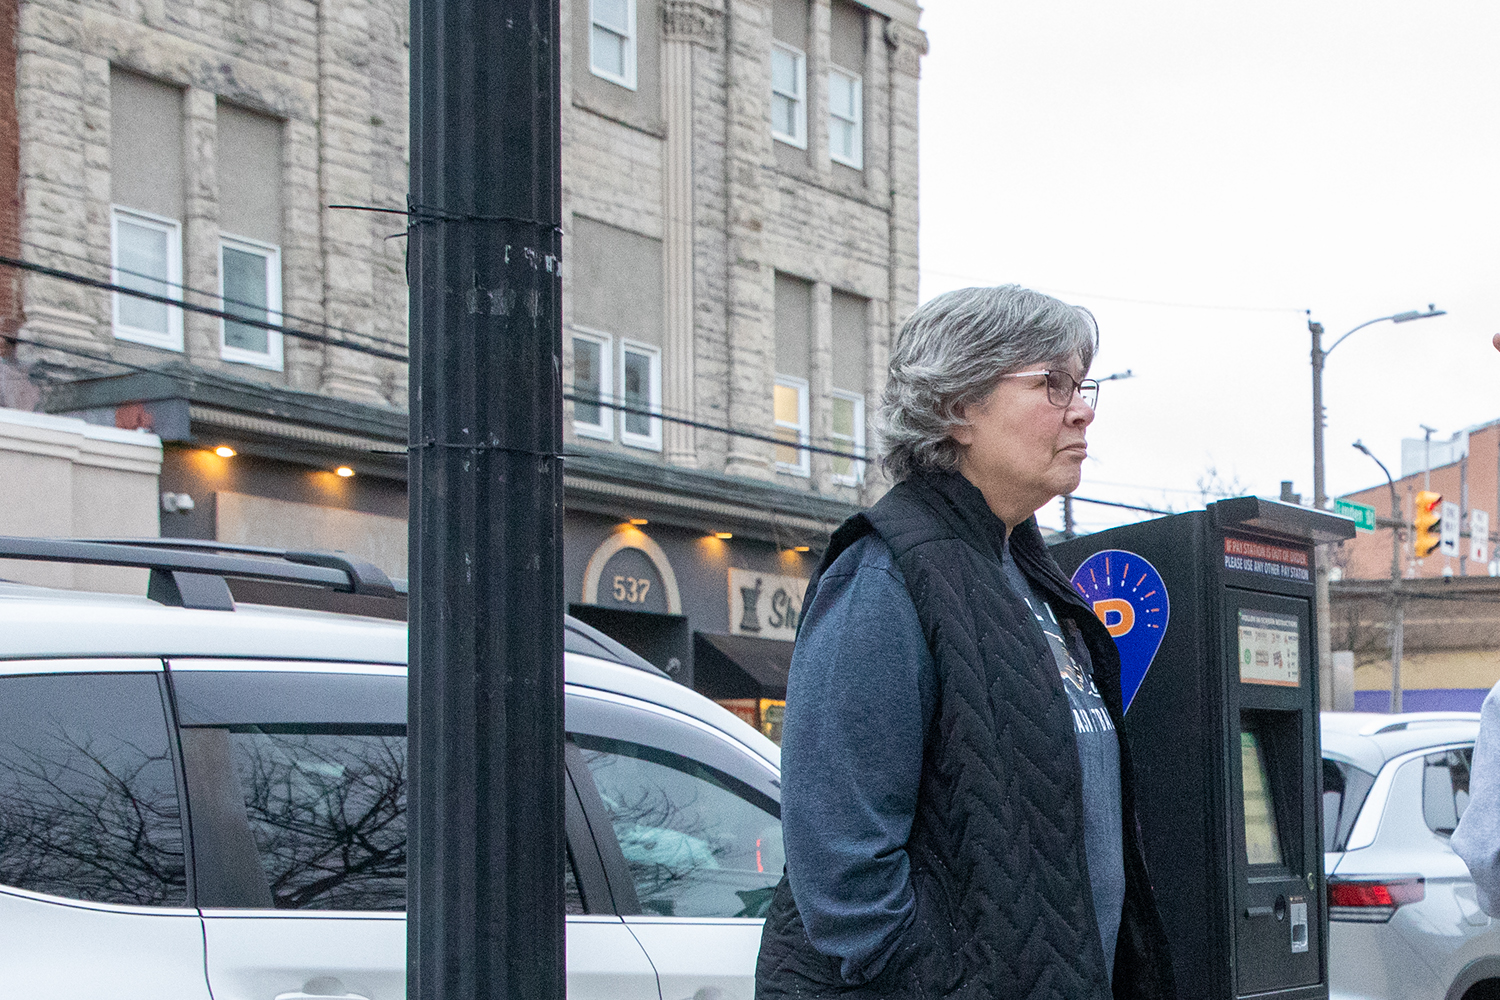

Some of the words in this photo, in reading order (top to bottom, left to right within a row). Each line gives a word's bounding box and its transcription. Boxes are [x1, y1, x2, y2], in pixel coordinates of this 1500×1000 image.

[1232, 540, 1243, 553] PAY
[1243, 541, 1266, 557] STATION
[1225, 555, 1243, 570] PLEASE
[1243, 558, 1253, 571] USE
[1254, 560, 1264, 573] ANY
[1264, 562, 1280, 576] OTHER
[1281, 565, 1290, 578] PAY
[1290, 566, 1309, 581] STATION
[613, 575, 651, 603] 537
[768, 588, 797, 629] Sh
